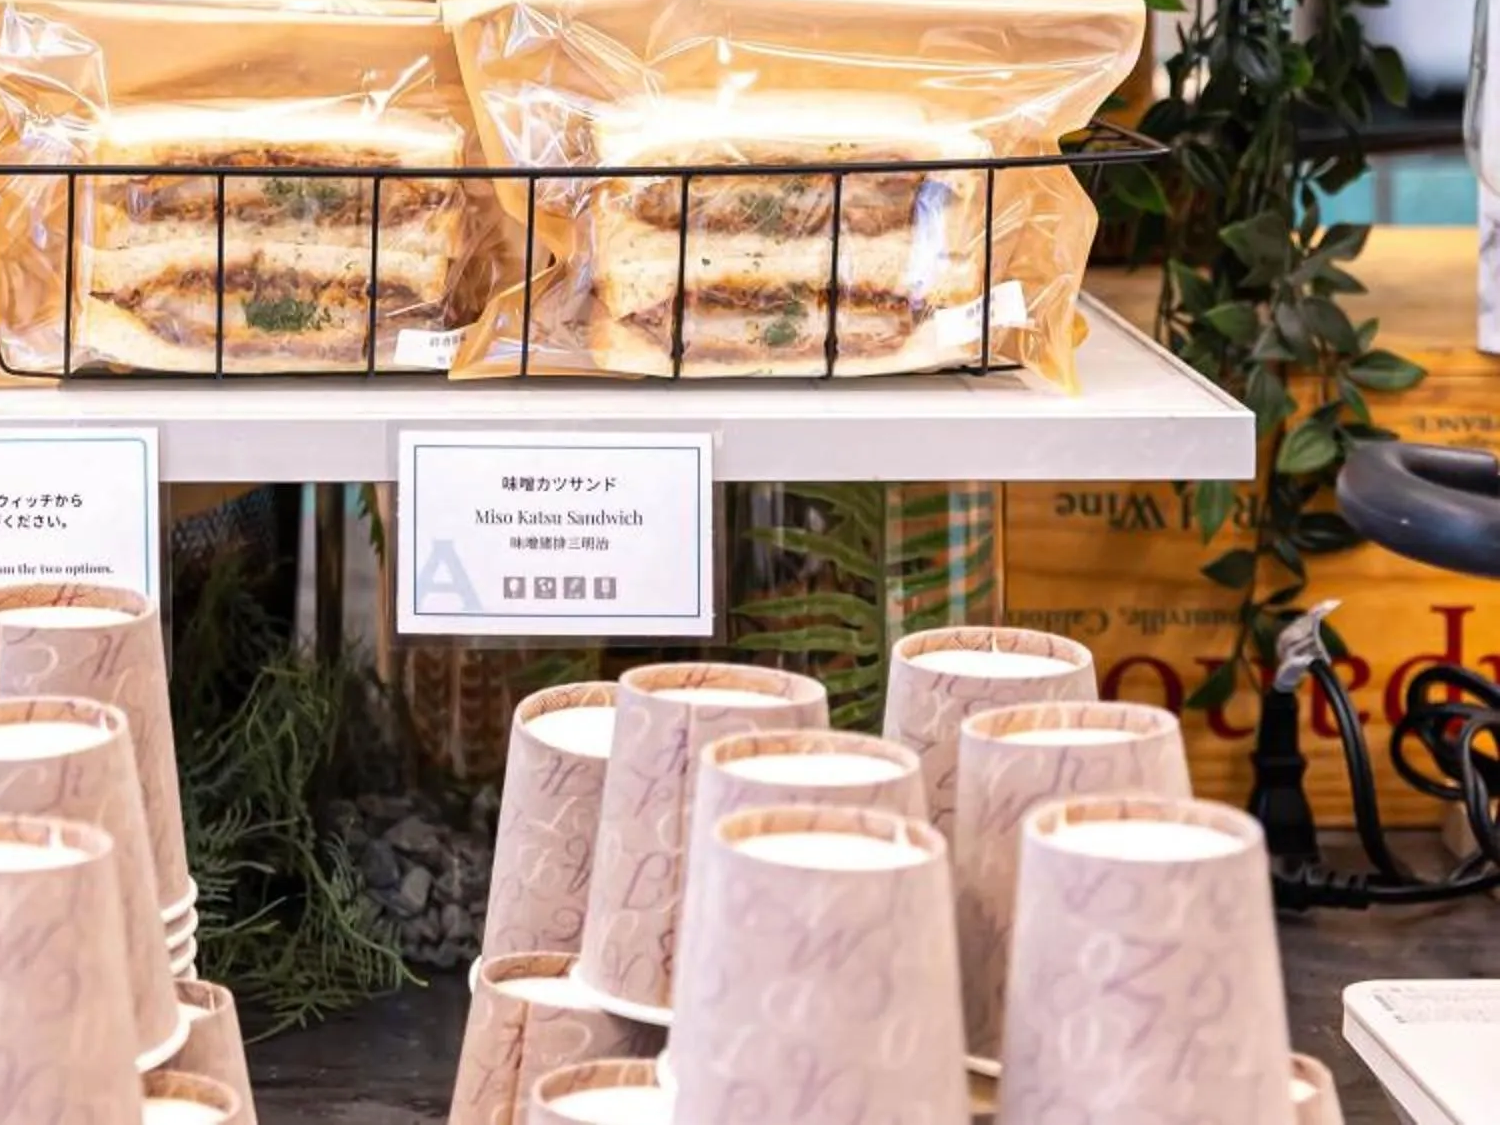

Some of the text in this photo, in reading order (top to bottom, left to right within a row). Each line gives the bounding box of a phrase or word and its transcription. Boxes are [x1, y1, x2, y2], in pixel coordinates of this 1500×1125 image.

[502, 475, 617, 493] 味噌カツサンド
[475, 508, 643, 527] Miso Katsu Sandwich
[1054, 491, 1168, 531] Wine
[17, 562, 37, 576] the
[40, 564, 63, 576] two
[65, 562, 114, 580] options.
